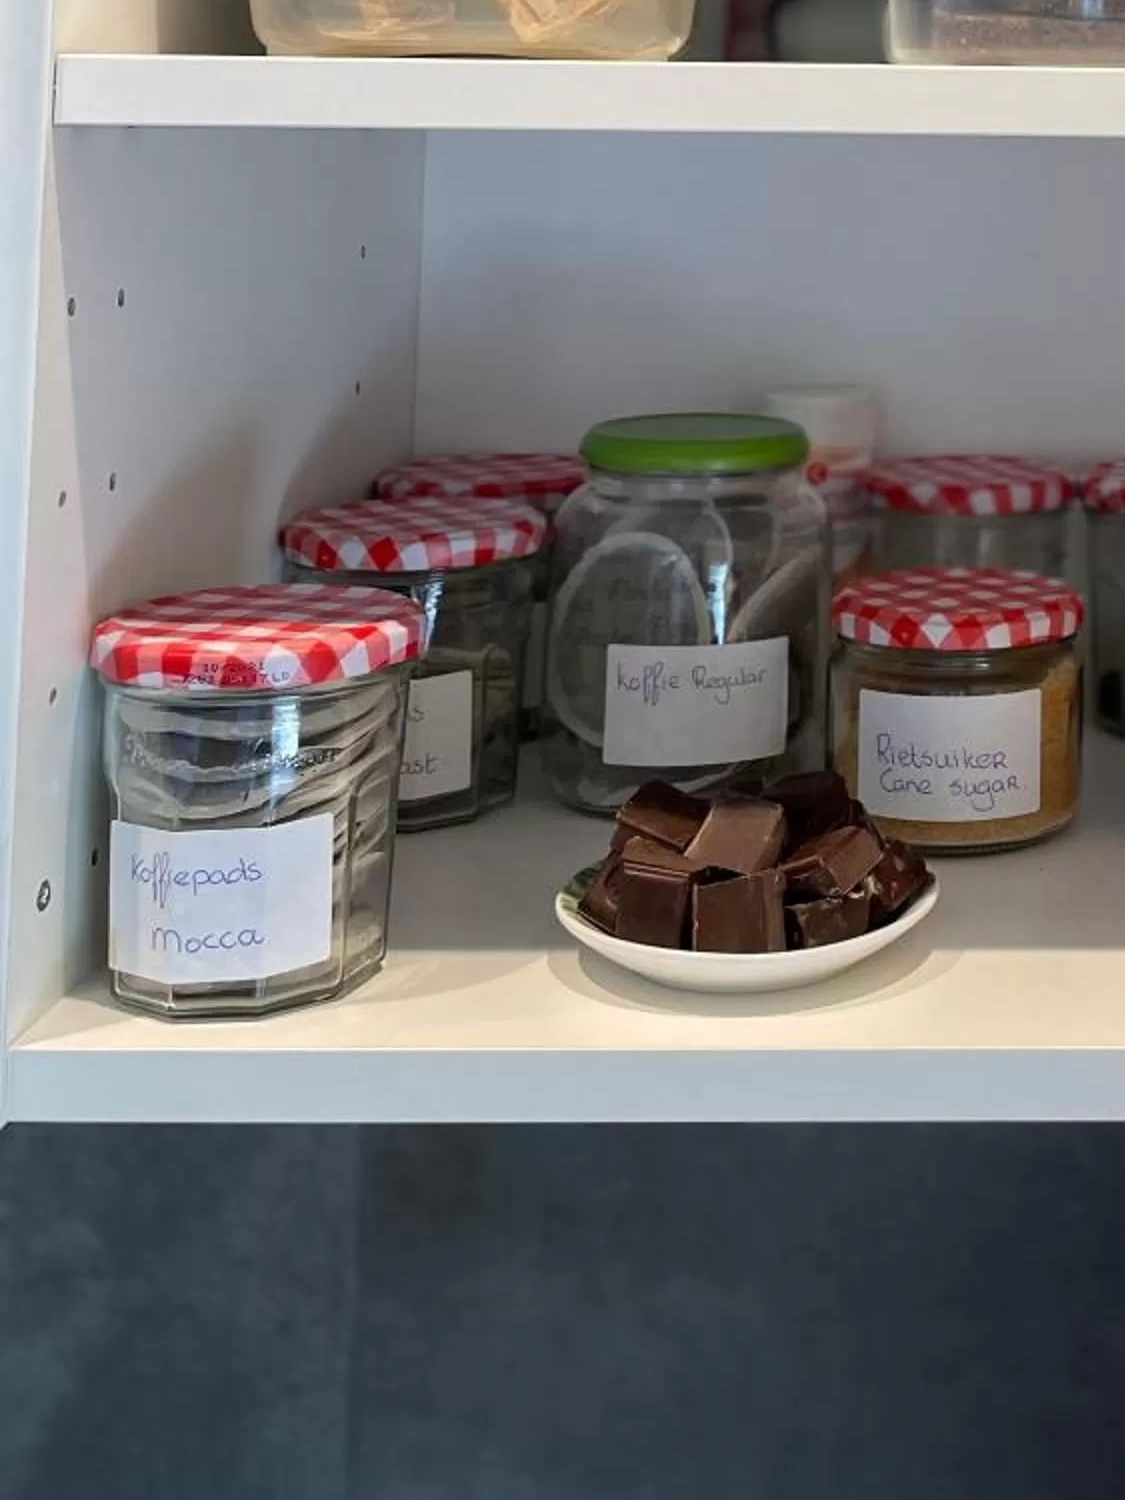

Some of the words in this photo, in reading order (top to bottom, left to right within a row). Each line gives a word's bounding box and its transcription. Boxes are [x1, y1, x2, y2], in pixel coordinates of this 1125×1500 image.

[689, 664, 768, 705] Regular
[879, 768, 933, 794] Cane
[948, 775, 1020, 812] sugar
[152, 927, 265, 953] Mocca
